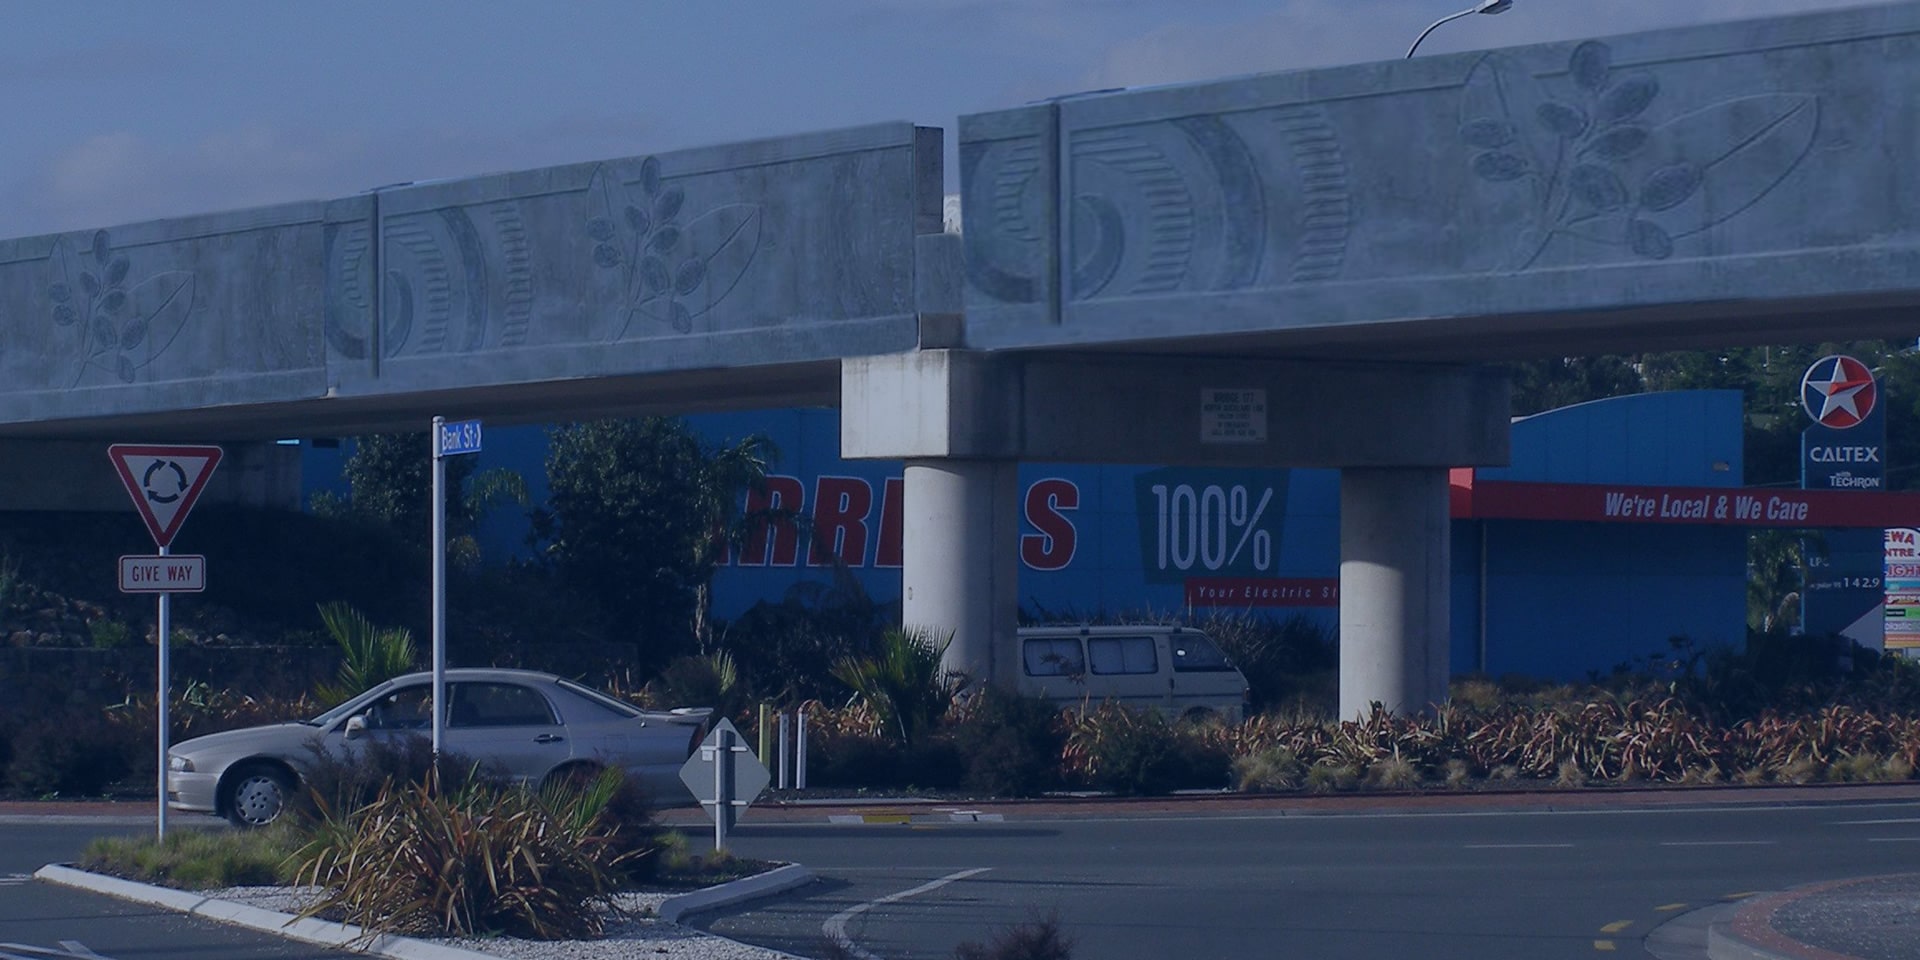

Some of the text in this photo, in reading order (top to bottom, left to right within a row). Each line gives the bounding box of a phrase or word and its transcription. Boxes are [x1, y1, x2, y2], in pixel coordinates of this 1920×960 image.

[442, 423, 474, 451] Bank St
[1810, 446, 1879, 463] CALTEX
[1829, 475, 1880, 488] TECHRON
[1605, 492, 1809, 520] We're Local & We Care
[1152, 484, 1273, 571] 100%
[132, 566, 192, 582] GIVE WAY
[1199, 586, 1234, 598] Your
[1244, 585, 1311, 598] Electric
